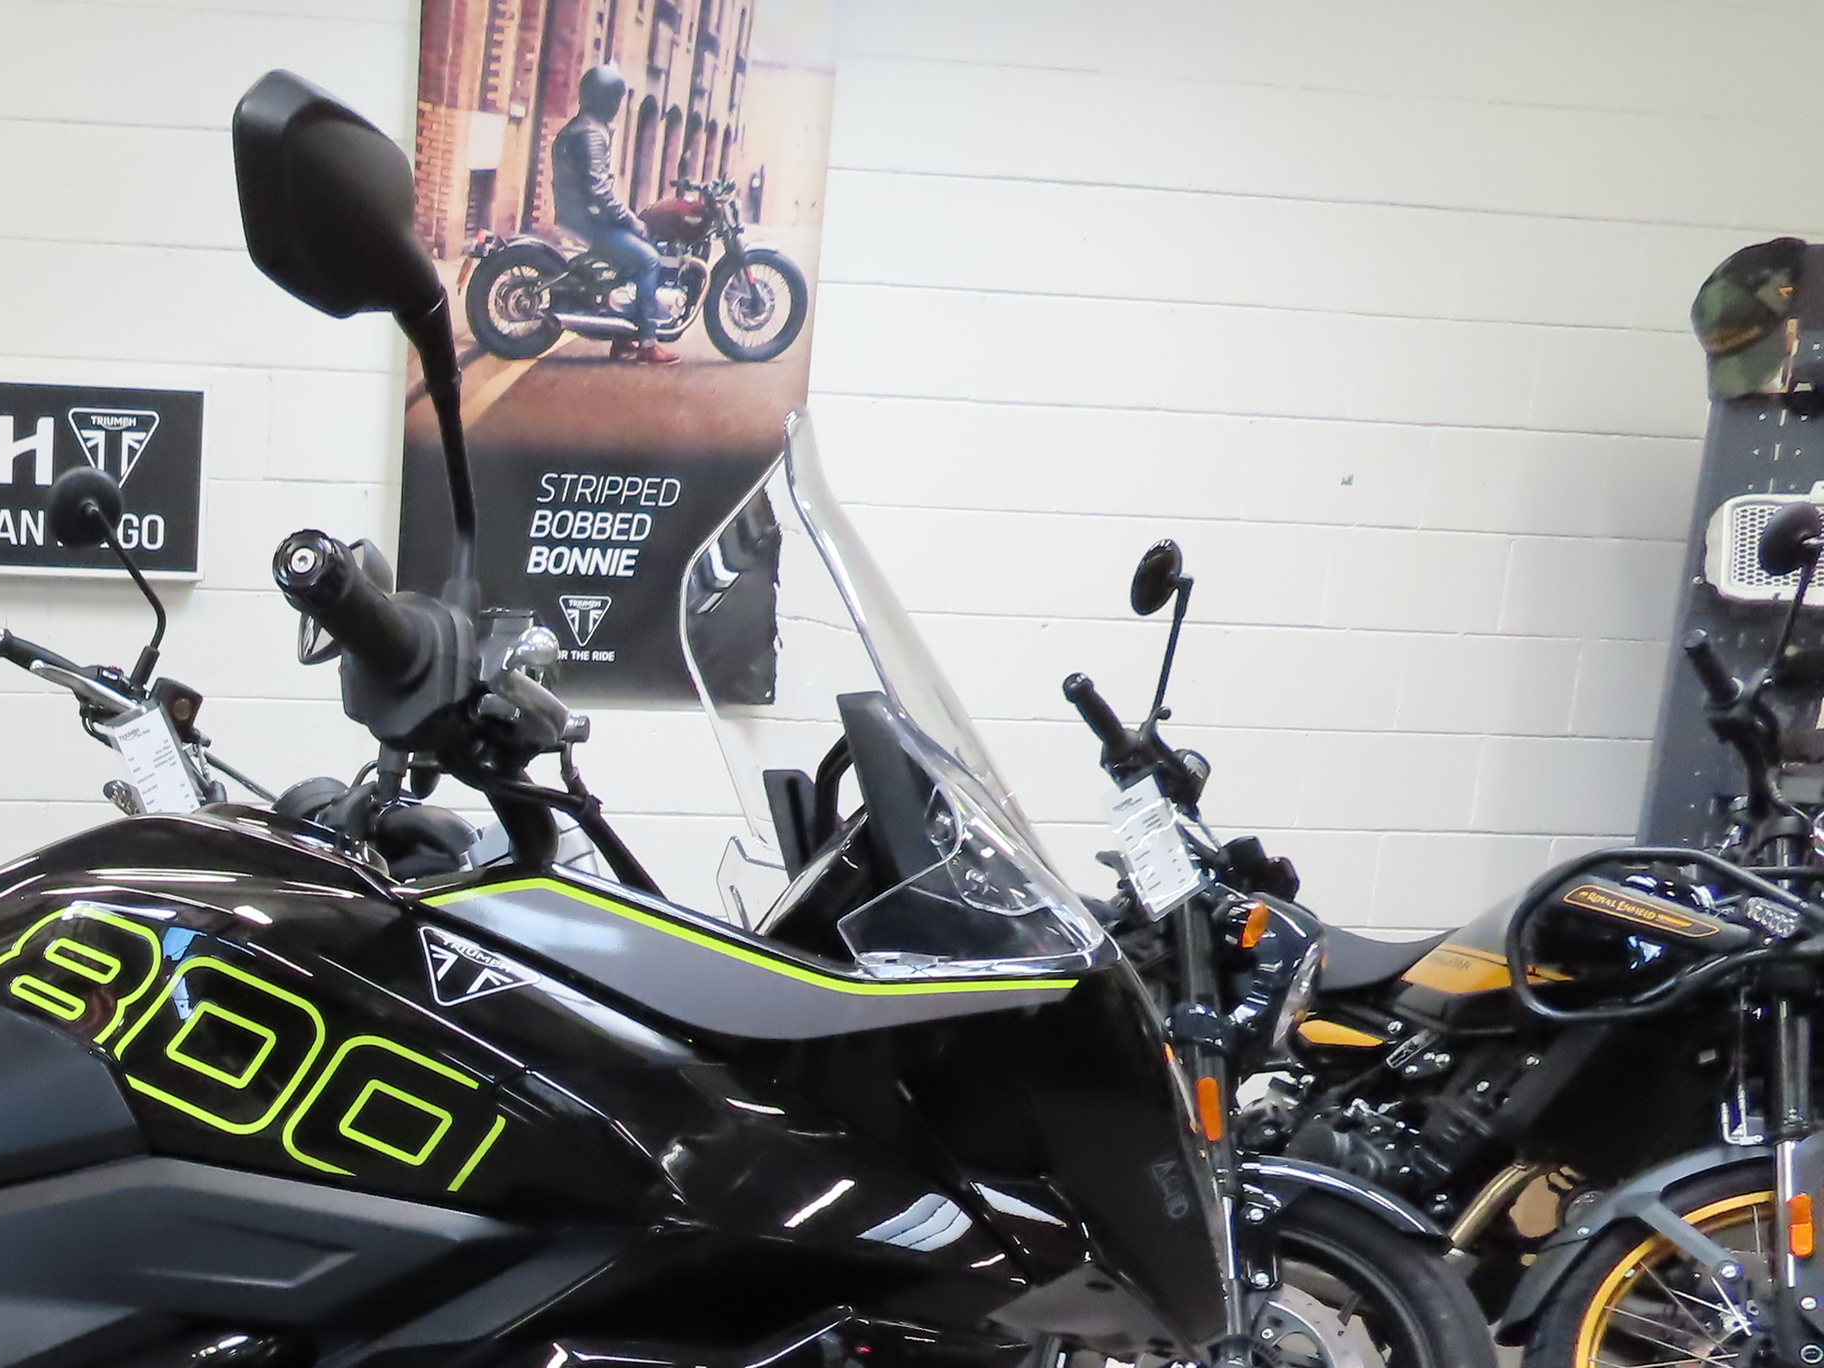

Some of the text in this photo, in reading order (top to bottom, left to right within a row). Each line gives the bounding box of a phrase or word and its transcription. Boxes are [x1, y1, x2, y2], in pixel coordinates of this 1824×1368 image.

[90, 415, 137, 430] TRIUMPH
[536, 472, 681, 507] STRIPPED
[529, 509, 652, 541] BOBBED
[526, 545, 640, 577] BONNIE
[570, 650, 590, 661] THE
[591, 650, 615, 662] RIDE
[442, 937, 513, 973] TRIUMPH
